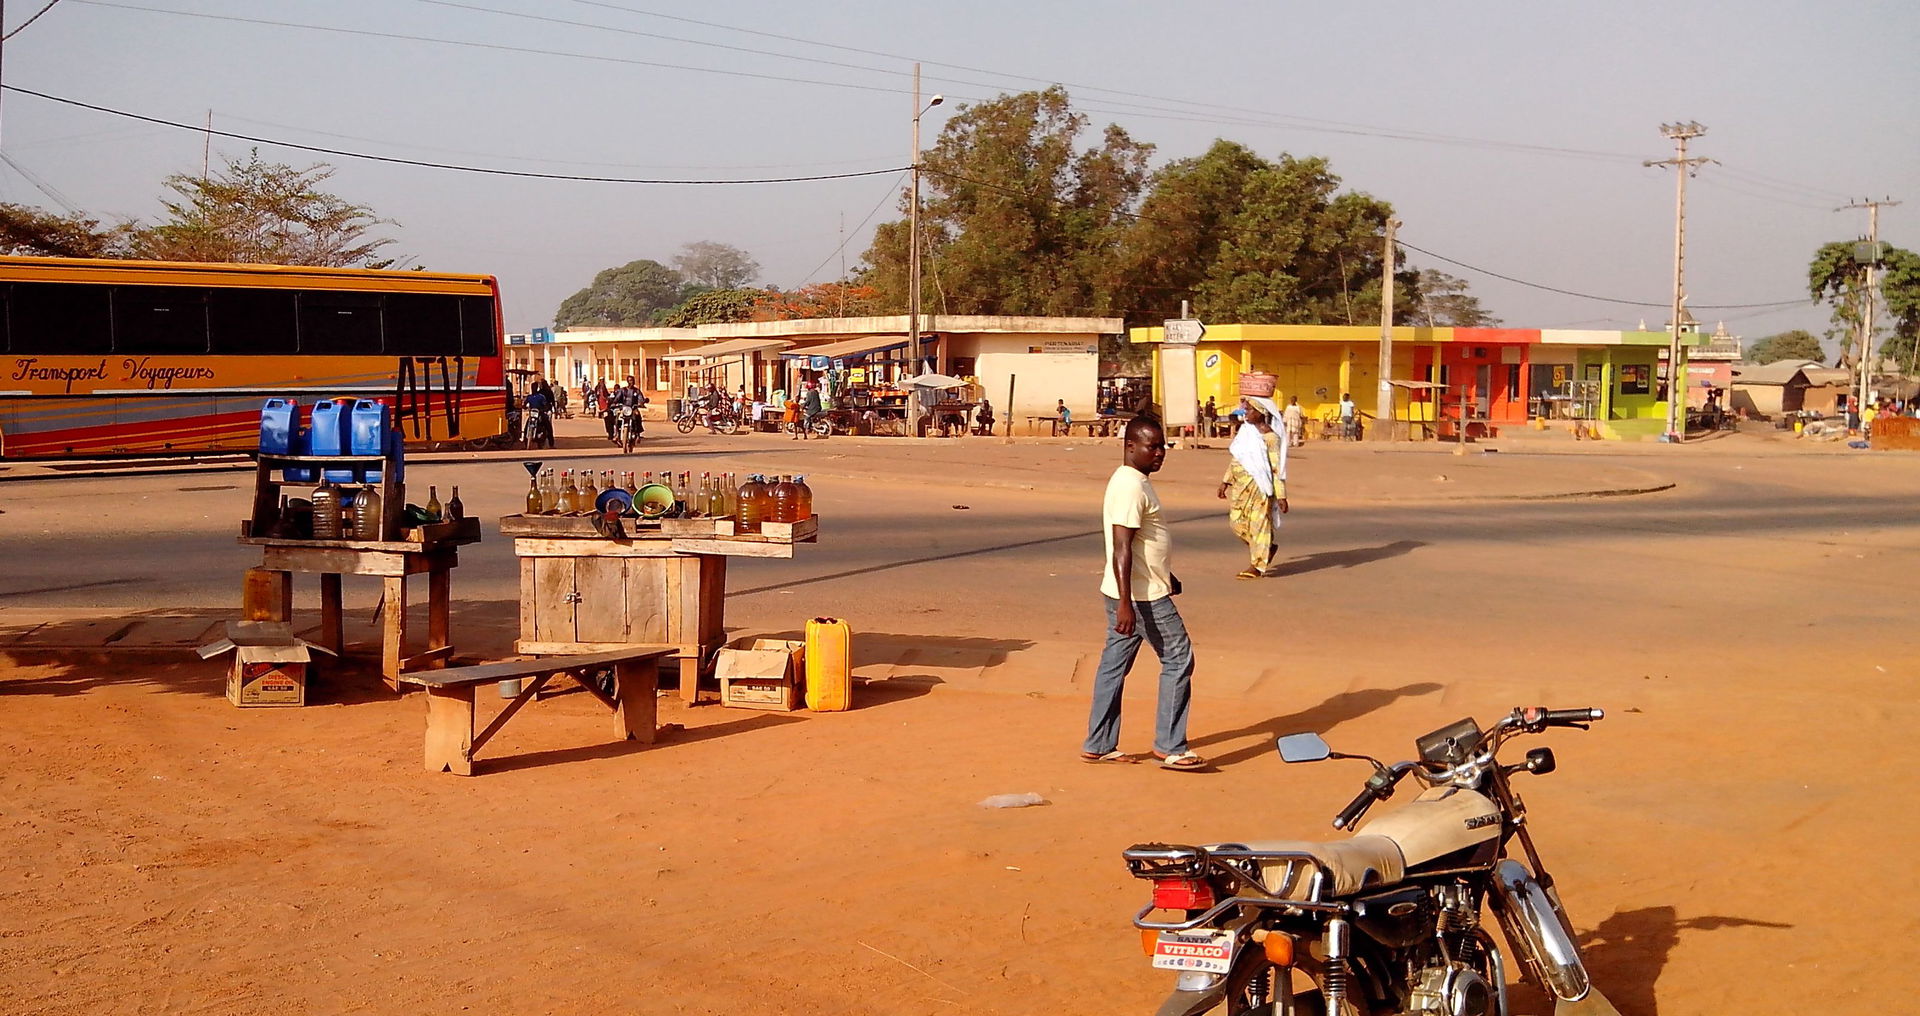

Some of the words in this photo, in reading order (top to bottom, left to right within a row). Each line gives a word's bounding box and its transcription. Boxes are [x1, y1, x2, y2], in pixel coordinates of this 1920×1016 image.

[12, 358, 108, 393] Transport
[123, 357, 214, 390] Voyageurs
[1163, 944, 1223, 957] VITRACO
